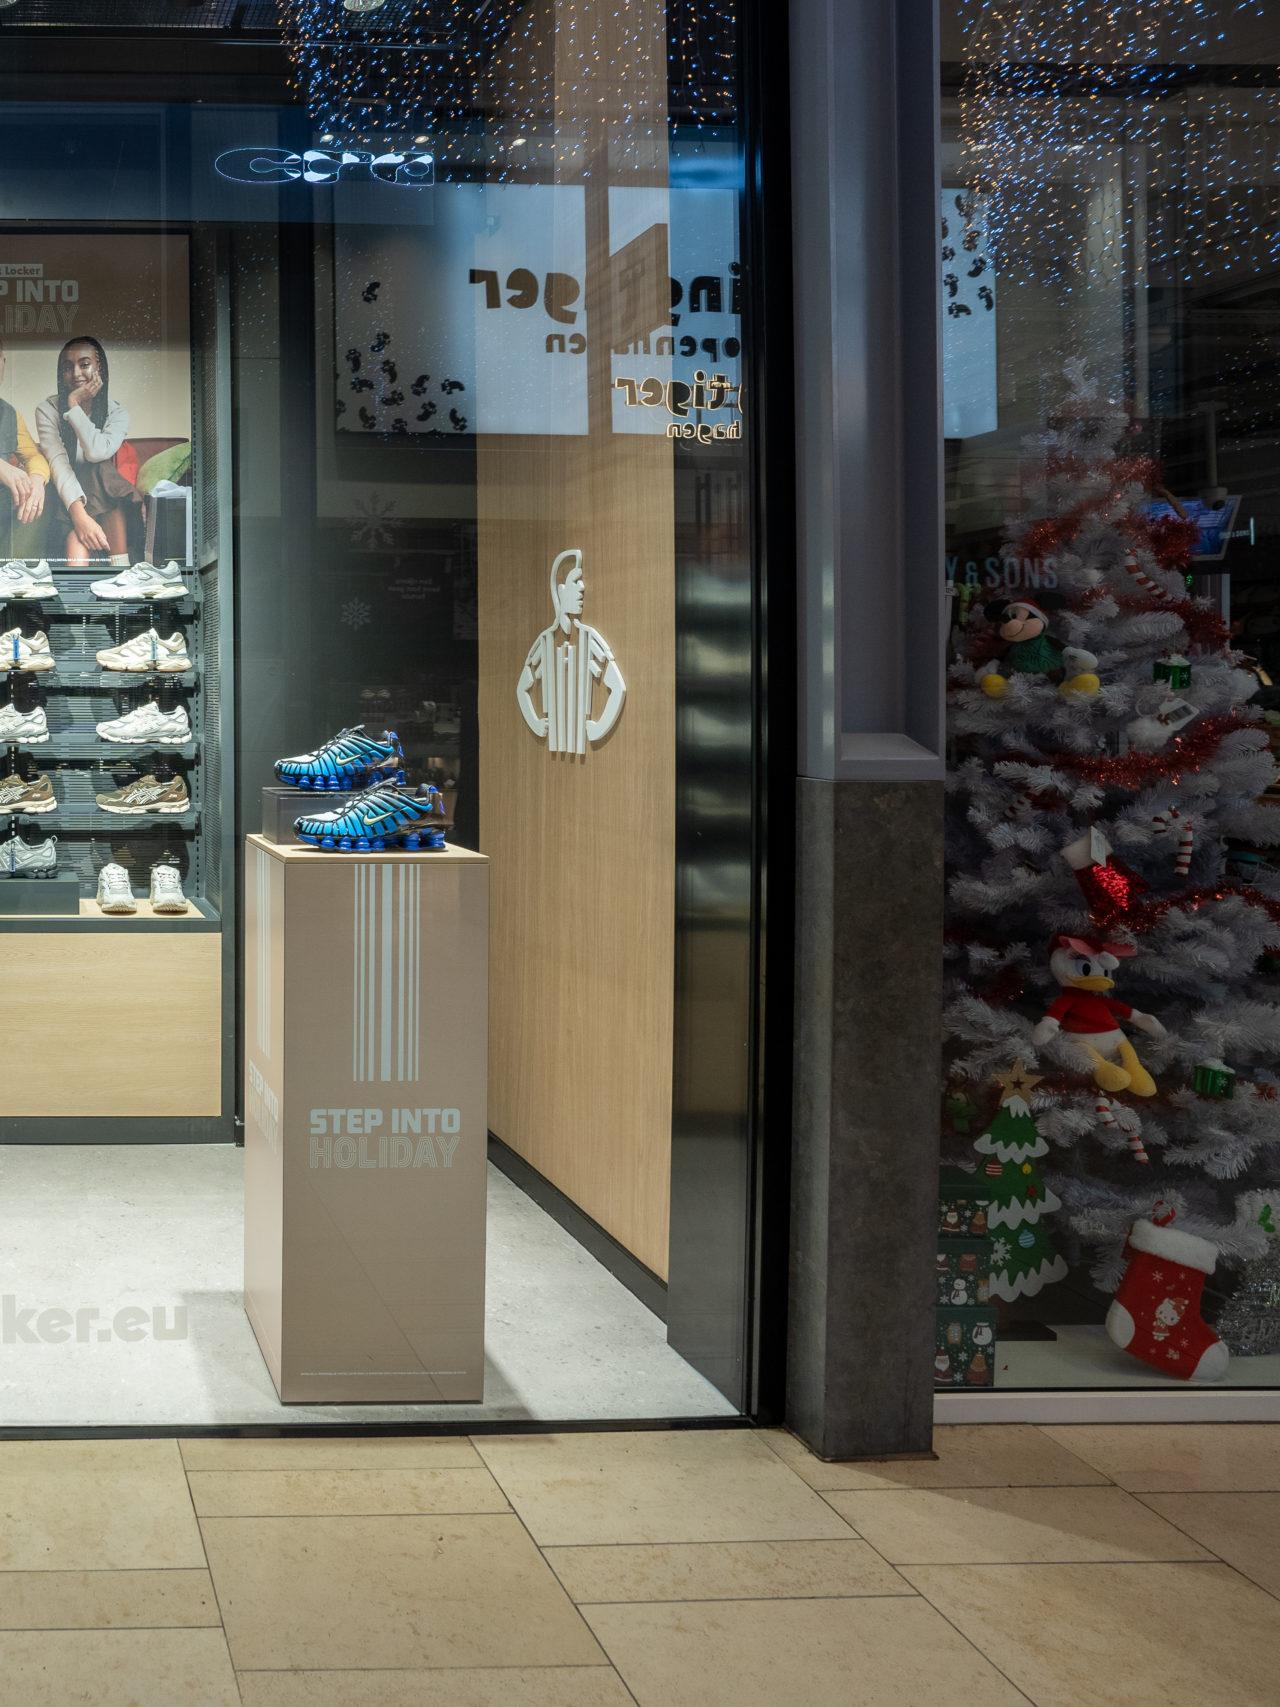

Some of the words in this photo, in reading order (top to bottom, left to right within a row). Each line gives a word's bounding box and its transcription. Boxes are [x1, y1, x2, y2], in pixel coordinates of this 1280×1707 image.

[5, 265, 41, 276] Locker
[16, 280, 80, 303] INTO
[985, 555, 1058, 590] SONS
[309, 1108, 383, 1134] STEP
[391, 1108, 461, 1134] INTO
[309, 1136, 461, 1169] HOLIDAY
